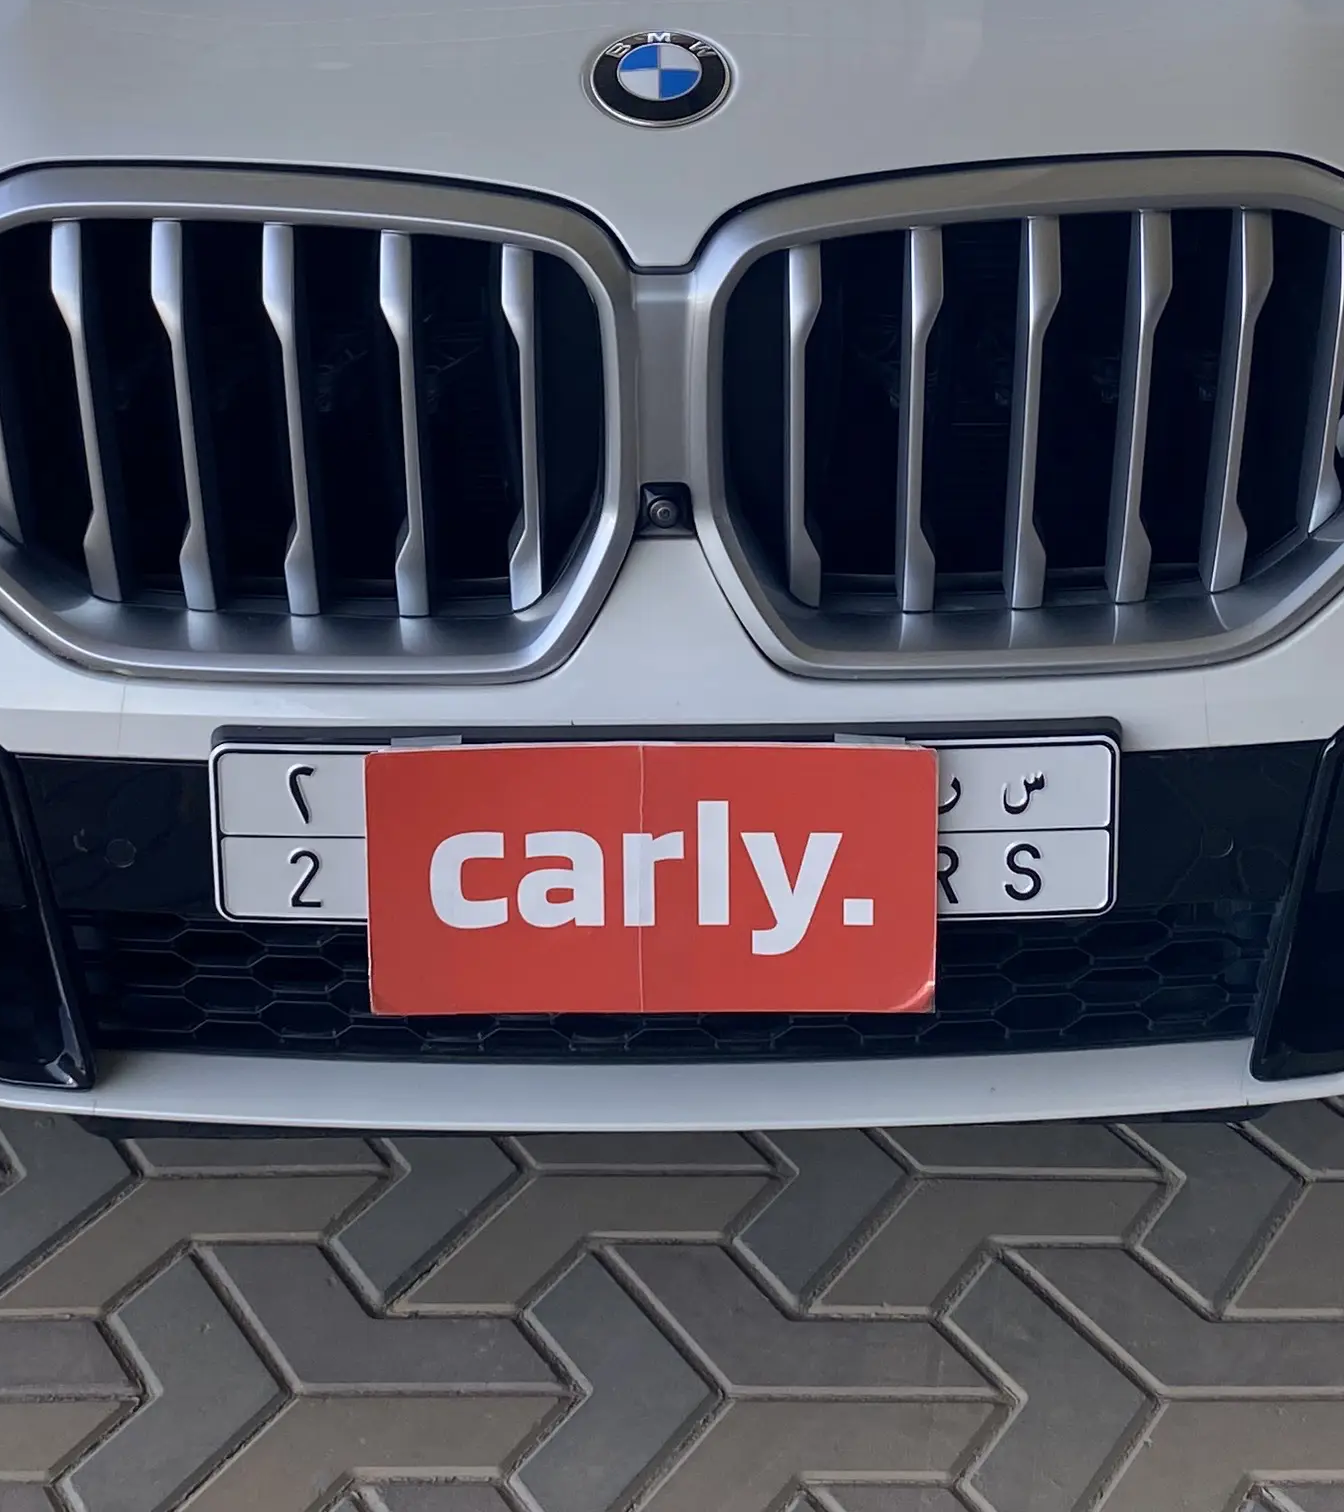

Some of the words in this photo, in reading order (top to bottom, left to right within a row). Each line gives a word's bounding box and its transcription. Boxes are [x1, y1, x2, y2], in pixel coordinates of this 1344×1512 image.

[605, 31, 718, 59] BMW
[289, 849, 323, 908] 2
[1003, 843, 1043, 902] S
[429, 799, 874, 956] carly.
